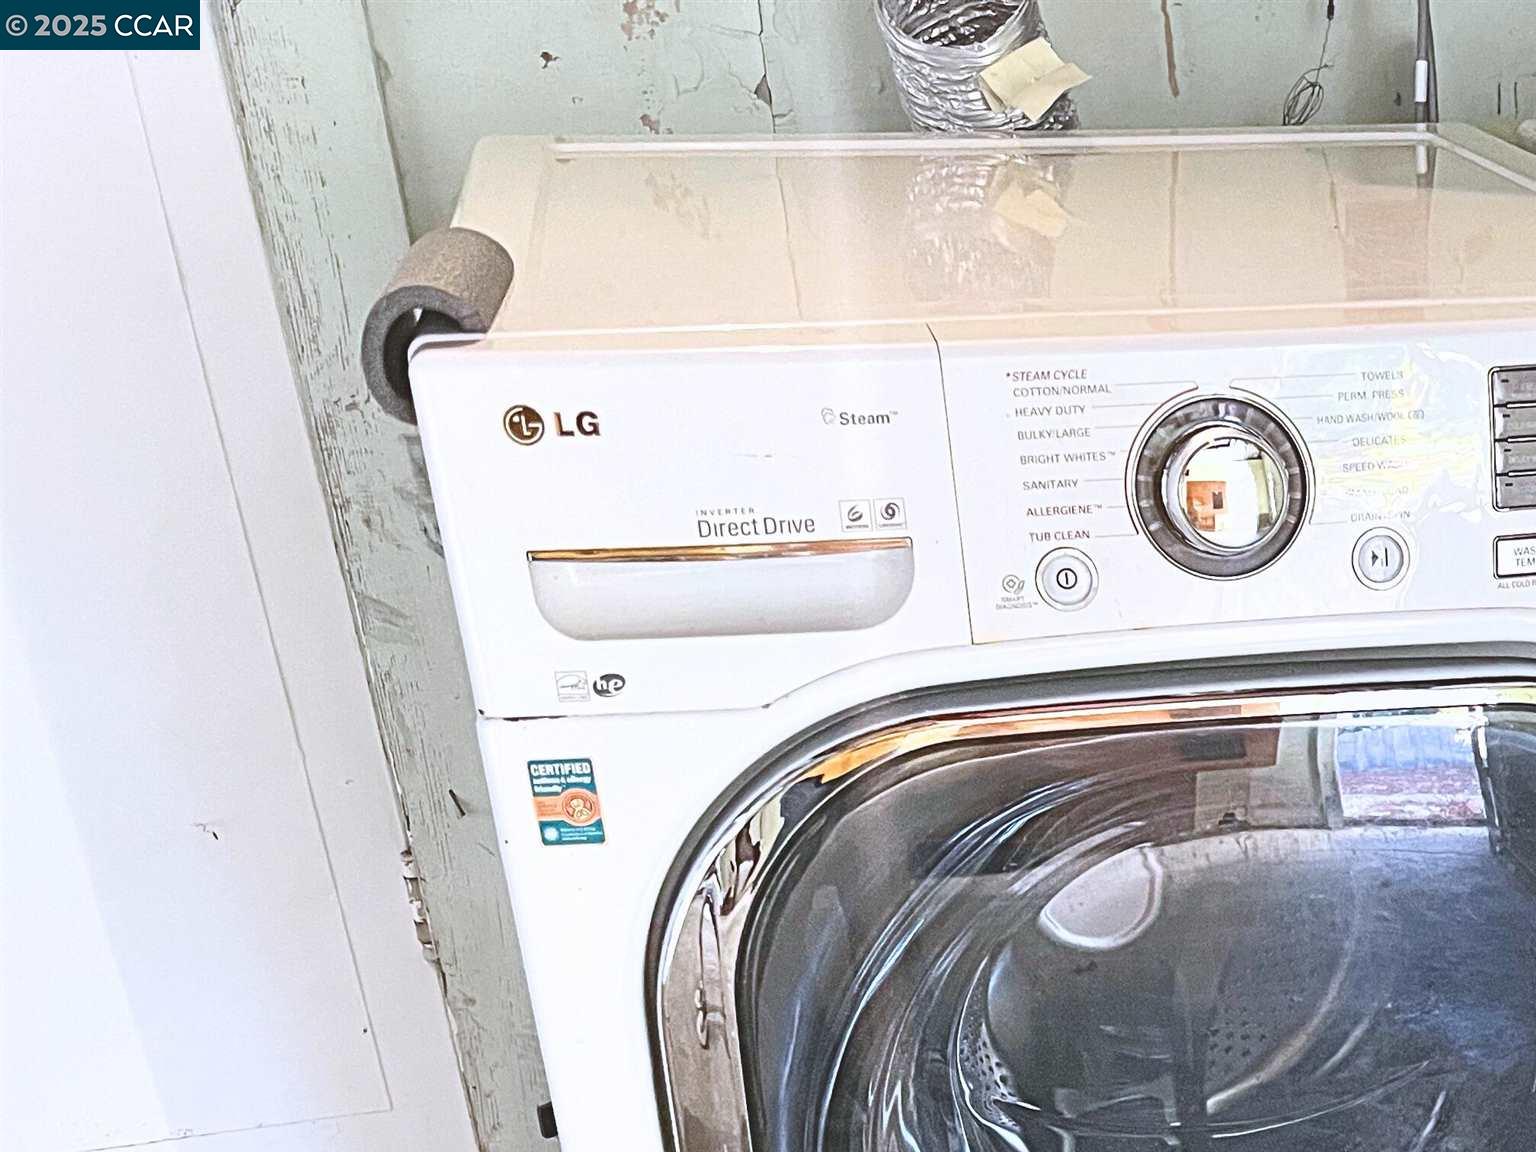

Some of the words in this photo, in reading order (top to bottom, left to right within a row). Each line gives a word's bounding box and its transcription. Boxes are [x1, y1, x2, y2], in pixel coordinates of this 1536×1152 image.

[1053, 369, 1087, 380] CYCLE
[1015, 406, 1053, 417] HEAVY
[1055, 405, 1087, 415] DUTY
[553, 410, 600, 437] LG
[1020, 453, 1060, 465] BRIGHT
[1022, 479, 1079, 491] SANITARY
[696, 507, 754, 516] INVERTER
[1028, 531, 1051, 542] TUB
[1054, 530, 1091, 540] CLEAN
[530, 762, 591, 777] CERTIFIED
